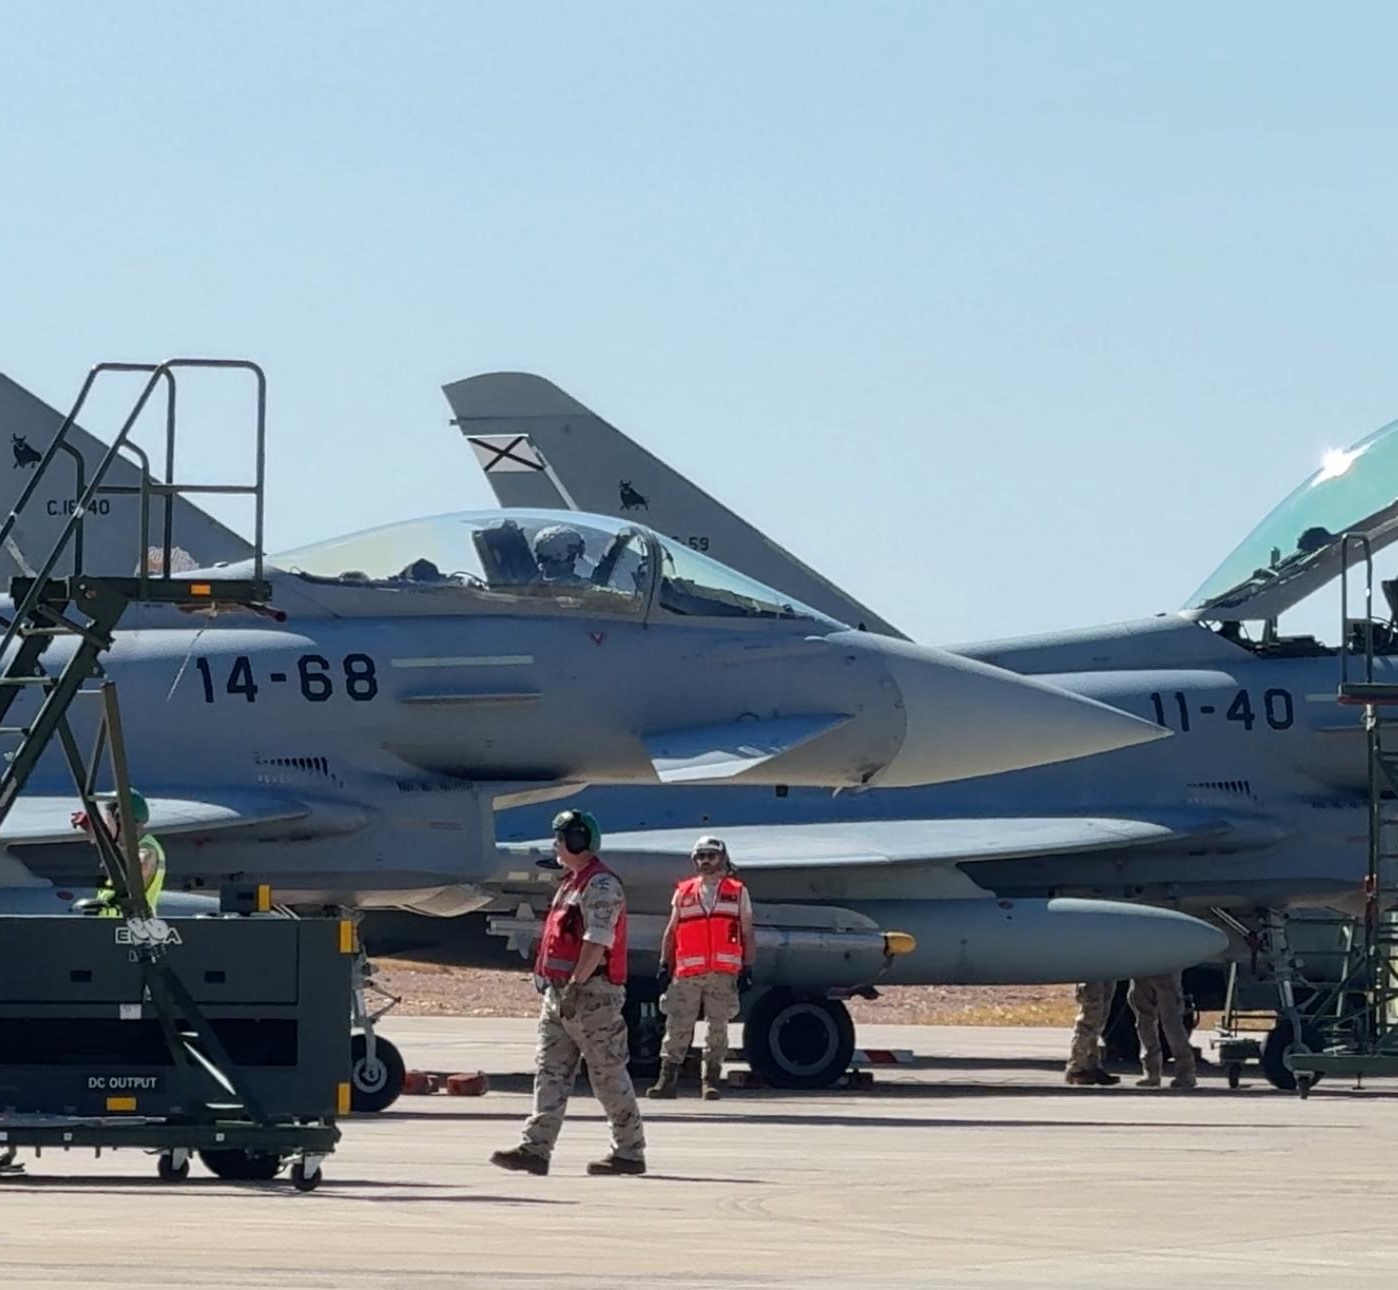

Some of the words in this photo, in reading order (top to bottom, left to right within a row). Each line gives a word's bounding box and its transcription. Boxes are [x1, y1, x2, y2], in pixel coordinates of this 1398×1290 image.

[196, 653, 378, 703] 14-68
[1150, 688, 1294, 732] 11-40
[115, 926, 183, 944] EA
[88, 1077, 106, 1089] DC
[109, 1077, 157, 1089] OUTPUT
